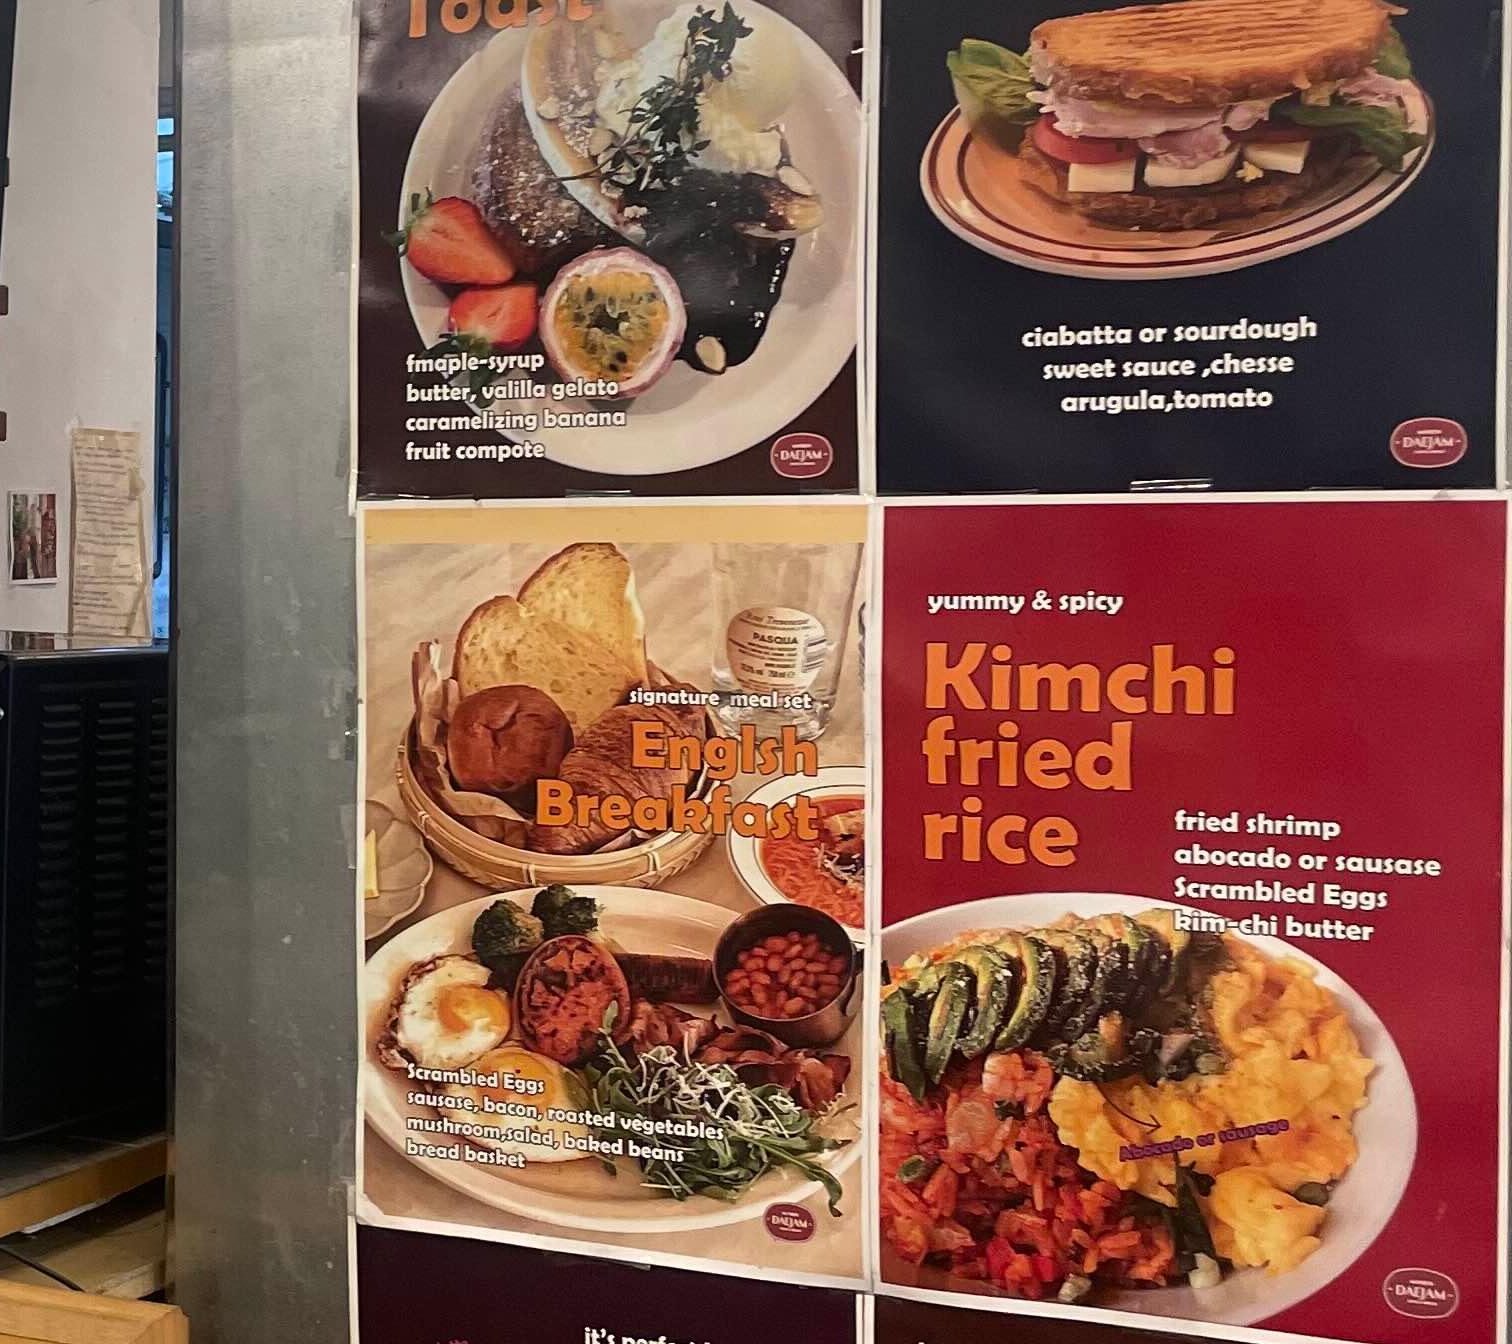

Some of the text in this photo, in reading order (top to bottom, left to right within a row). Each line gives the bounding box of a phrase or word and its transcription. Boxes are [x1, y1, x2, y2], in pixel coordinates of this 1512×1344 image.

[1021, 315, 1318, 349] ciabatta or sourdough
[406, 353, 545, 374] fmaple-syrup
[1042, 358, 1116, 381] sweet
[1122, 358, 1195, 379] sauce
[406, 378, 619, 404] butter, valilla gelato
[1060, 388, 1274, 414] arugula,tomato
[405, 409, 627, 433] caramelizing banana
[405, 442, 545, 462] fruit compote
[927, 589, 1124, 616] yummy & spicy
[924, 641, 1237, 715] Kimchi
[629, 687, 813, 709] signature meal set
[922, 715, 1134, 791] fried
[535, 778, 819, 841] Breakfast
[1174, 809, 1342, 842] fried shrimp
[922, 796, 1079, 867] rice
[1174, 844, 1442, 877] abocado or sausase
[1173, 875, 1388, 912] Scrambled Eggs
[1173, 908, 1375, 942] kim-chi butter
[406, 1061, 545, 1095] Scrambled Eggs
[406, 1091, 725, 1142] sausase, bacon, roasted vegetables
[406, 1138, 526, 1169] bread basket
[563, 1130, 623, 1156] baked
[627, 1138, 684, 1164] beans
[1196, 1132, 1216, 1147] or
